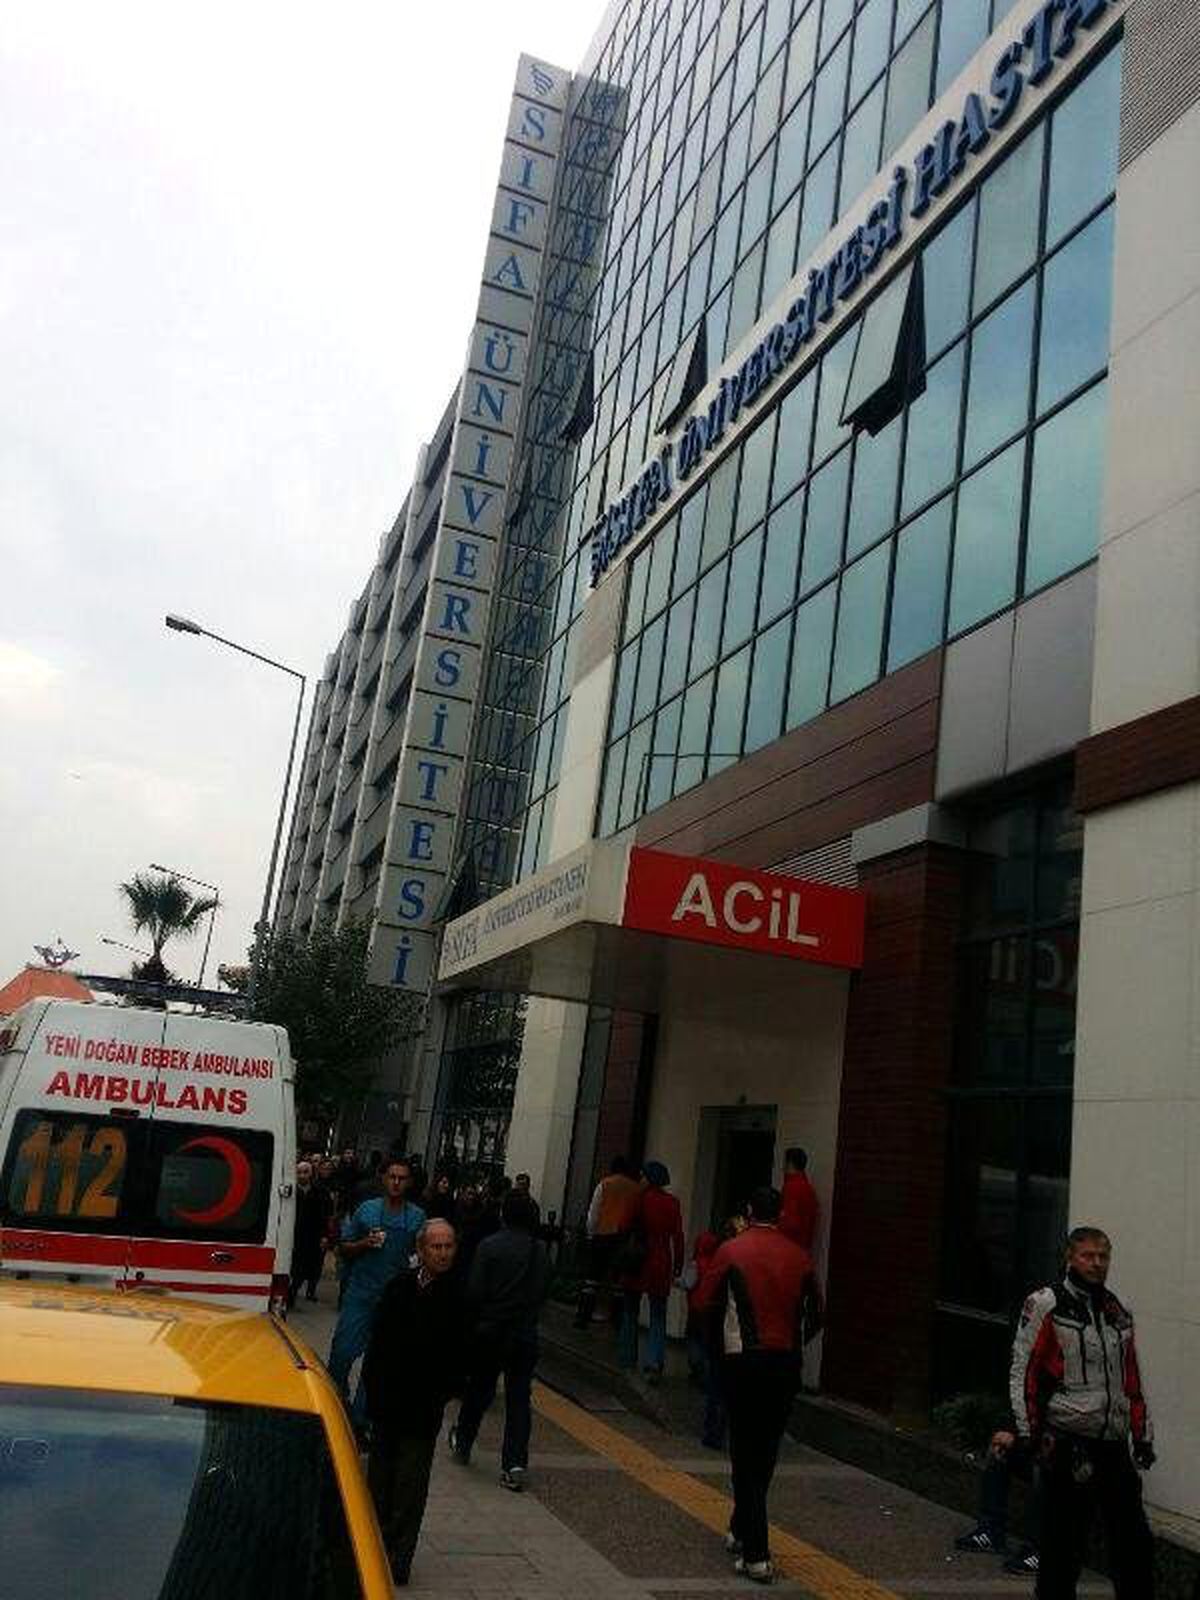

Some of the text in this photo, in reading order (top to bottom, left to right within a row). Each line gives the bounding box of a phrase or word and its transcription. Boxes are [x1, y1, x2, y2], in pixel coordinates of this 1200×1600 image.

[390, 332, 514, 986] ÜNİVERSİTESİ
[45, 1035, 274, 1080] YENİ DOĞAN BEBEK AMBULANSI
[46, 1071, 248, 1115] AMBULANS
[20, 1122, 127, 1217] 112
